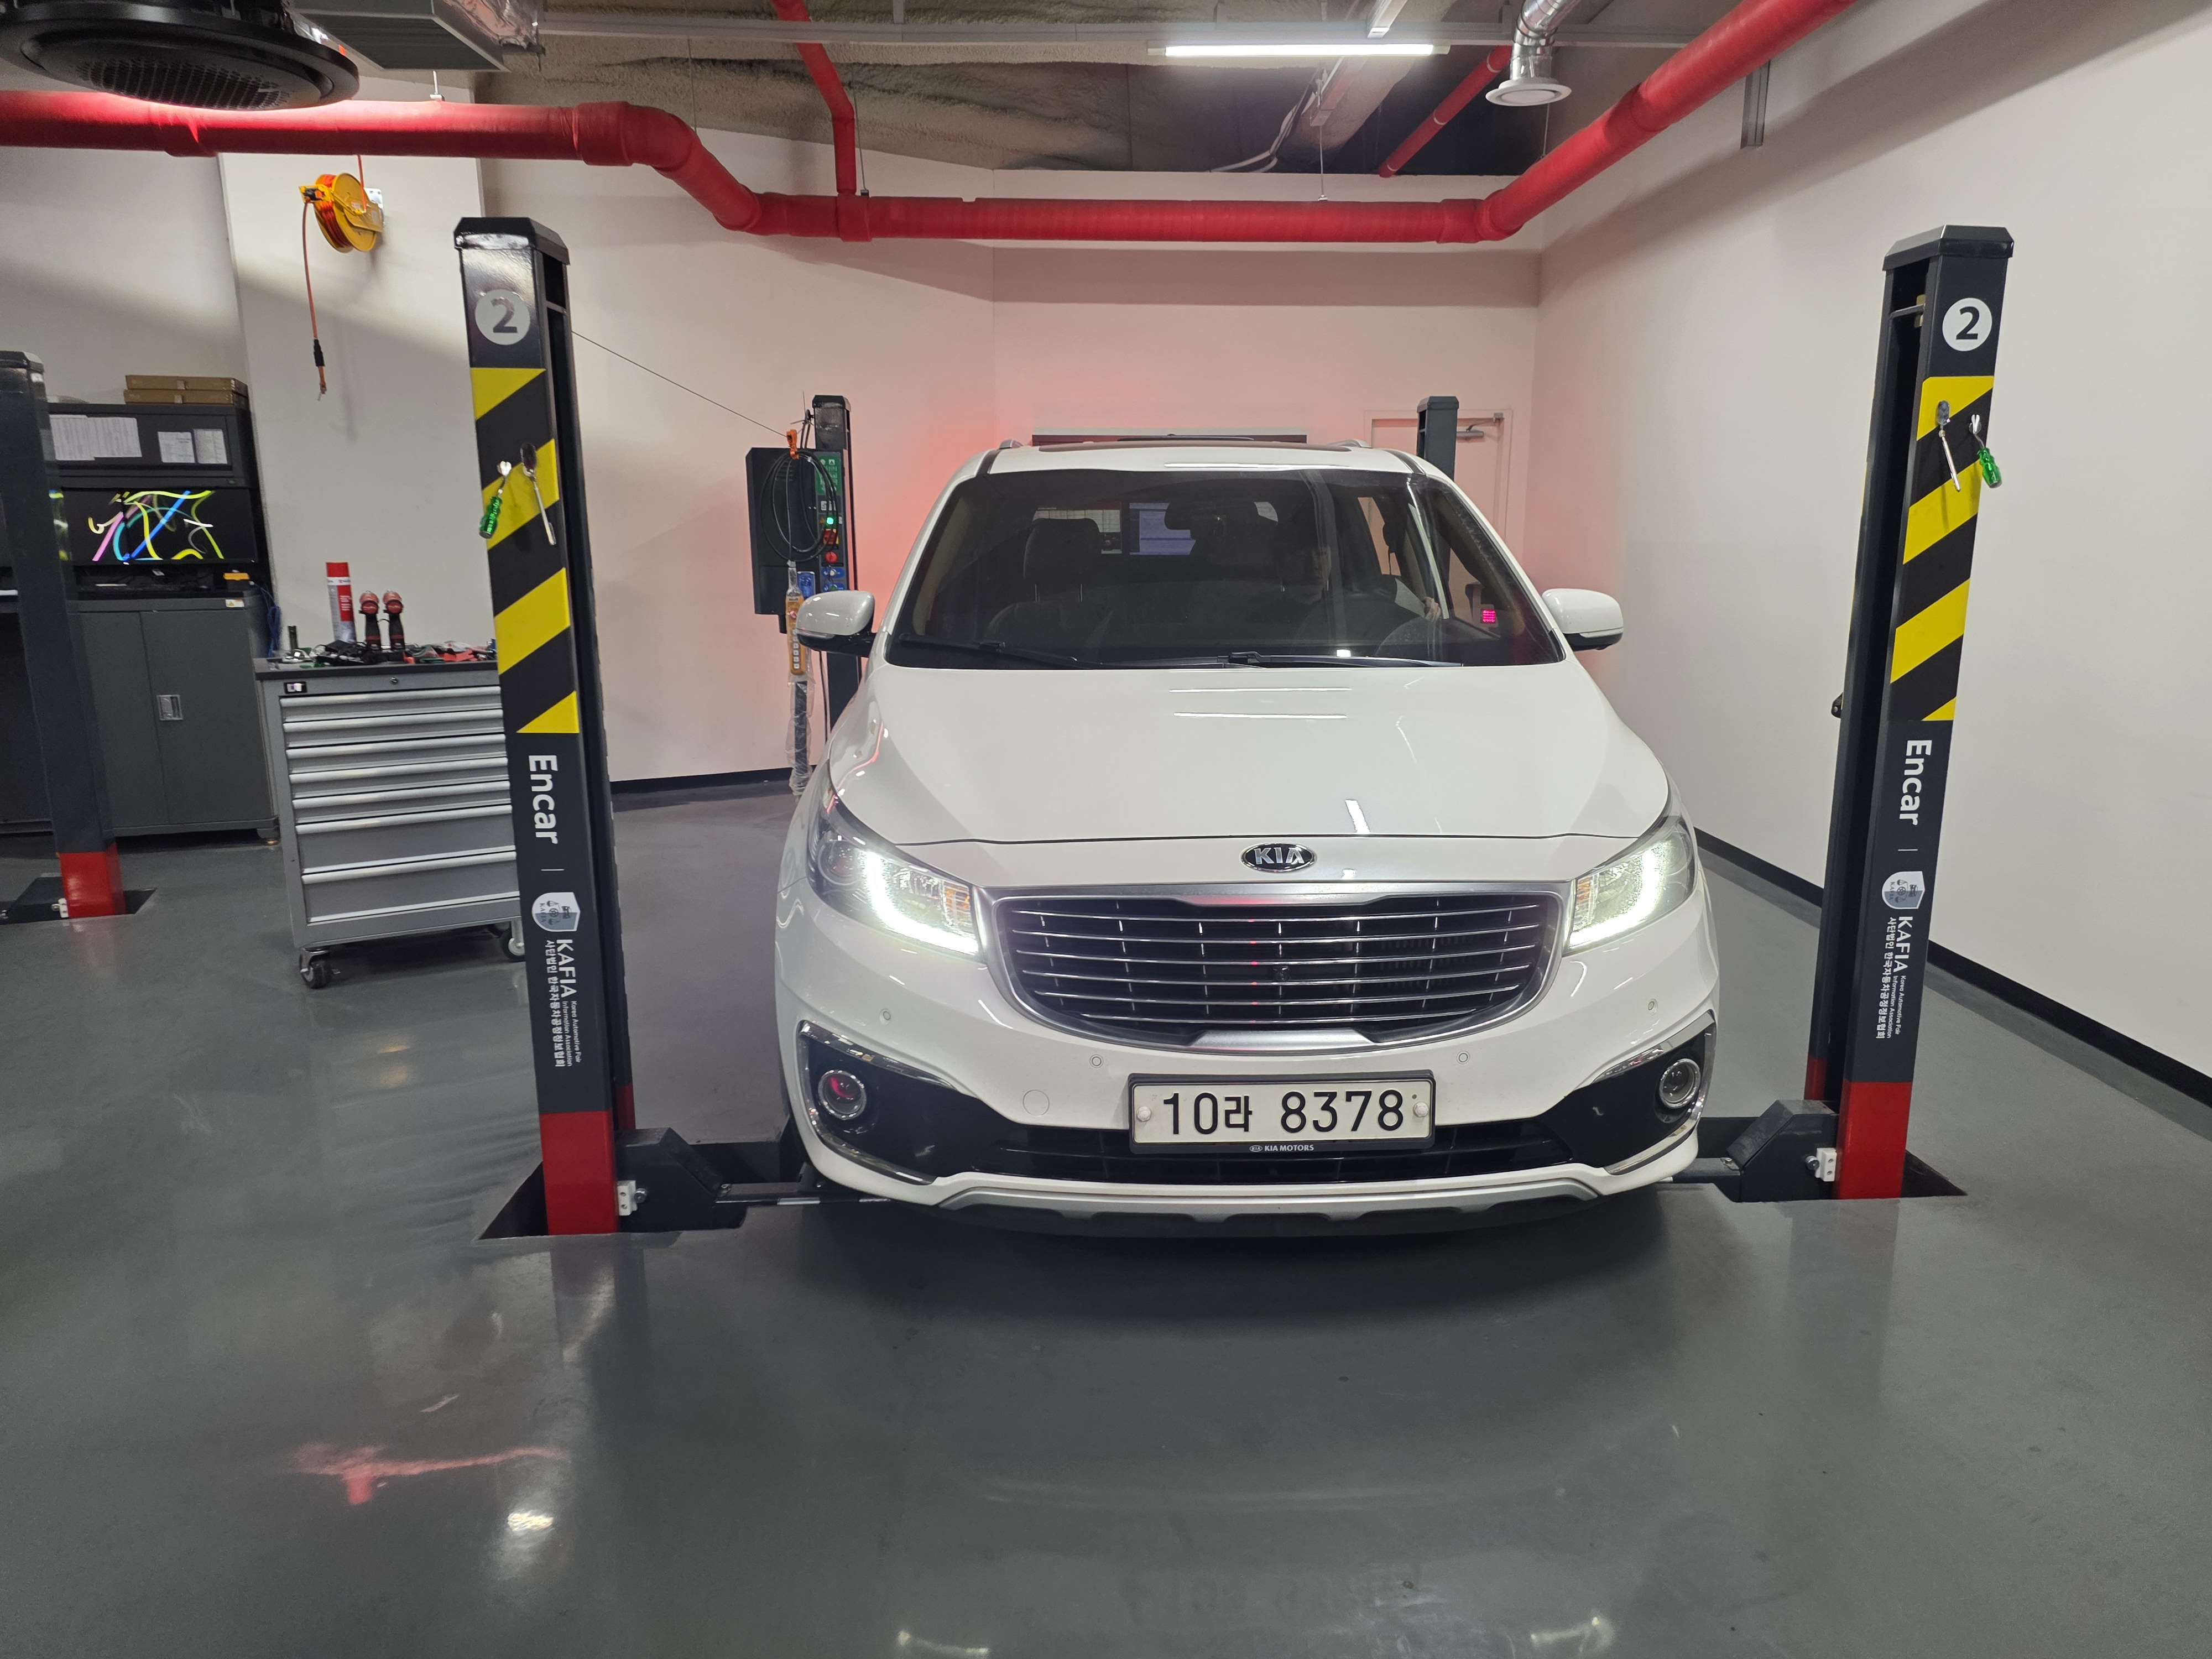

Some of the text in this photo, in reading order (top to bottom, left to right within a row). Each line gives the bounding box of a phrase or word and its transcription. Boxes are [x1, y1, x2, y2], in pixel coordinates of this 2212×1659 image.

[491, 297, 518, 333] 2
[1955, 306, 1980, 340] 2
[529, 755, 558, 844] Encar
[1899, 740, 1932, 826] Encar
[1253, 847, 1305, 865] KIA
[1885, 917, 1897, 950] 사단법인
[1893, 916, 1913, 973] KAFIA
[556, 939, 577, 998] KAFIA
[562, 1000, 570, 1034] Information
[1886, 975, 1898, 1039] Information Association
[1896, 993, 1905, 1024] Automotive
[572, 1019, 581, 1051] Automotive
[1163, 1089, 1405, 1135] 10라 8378
